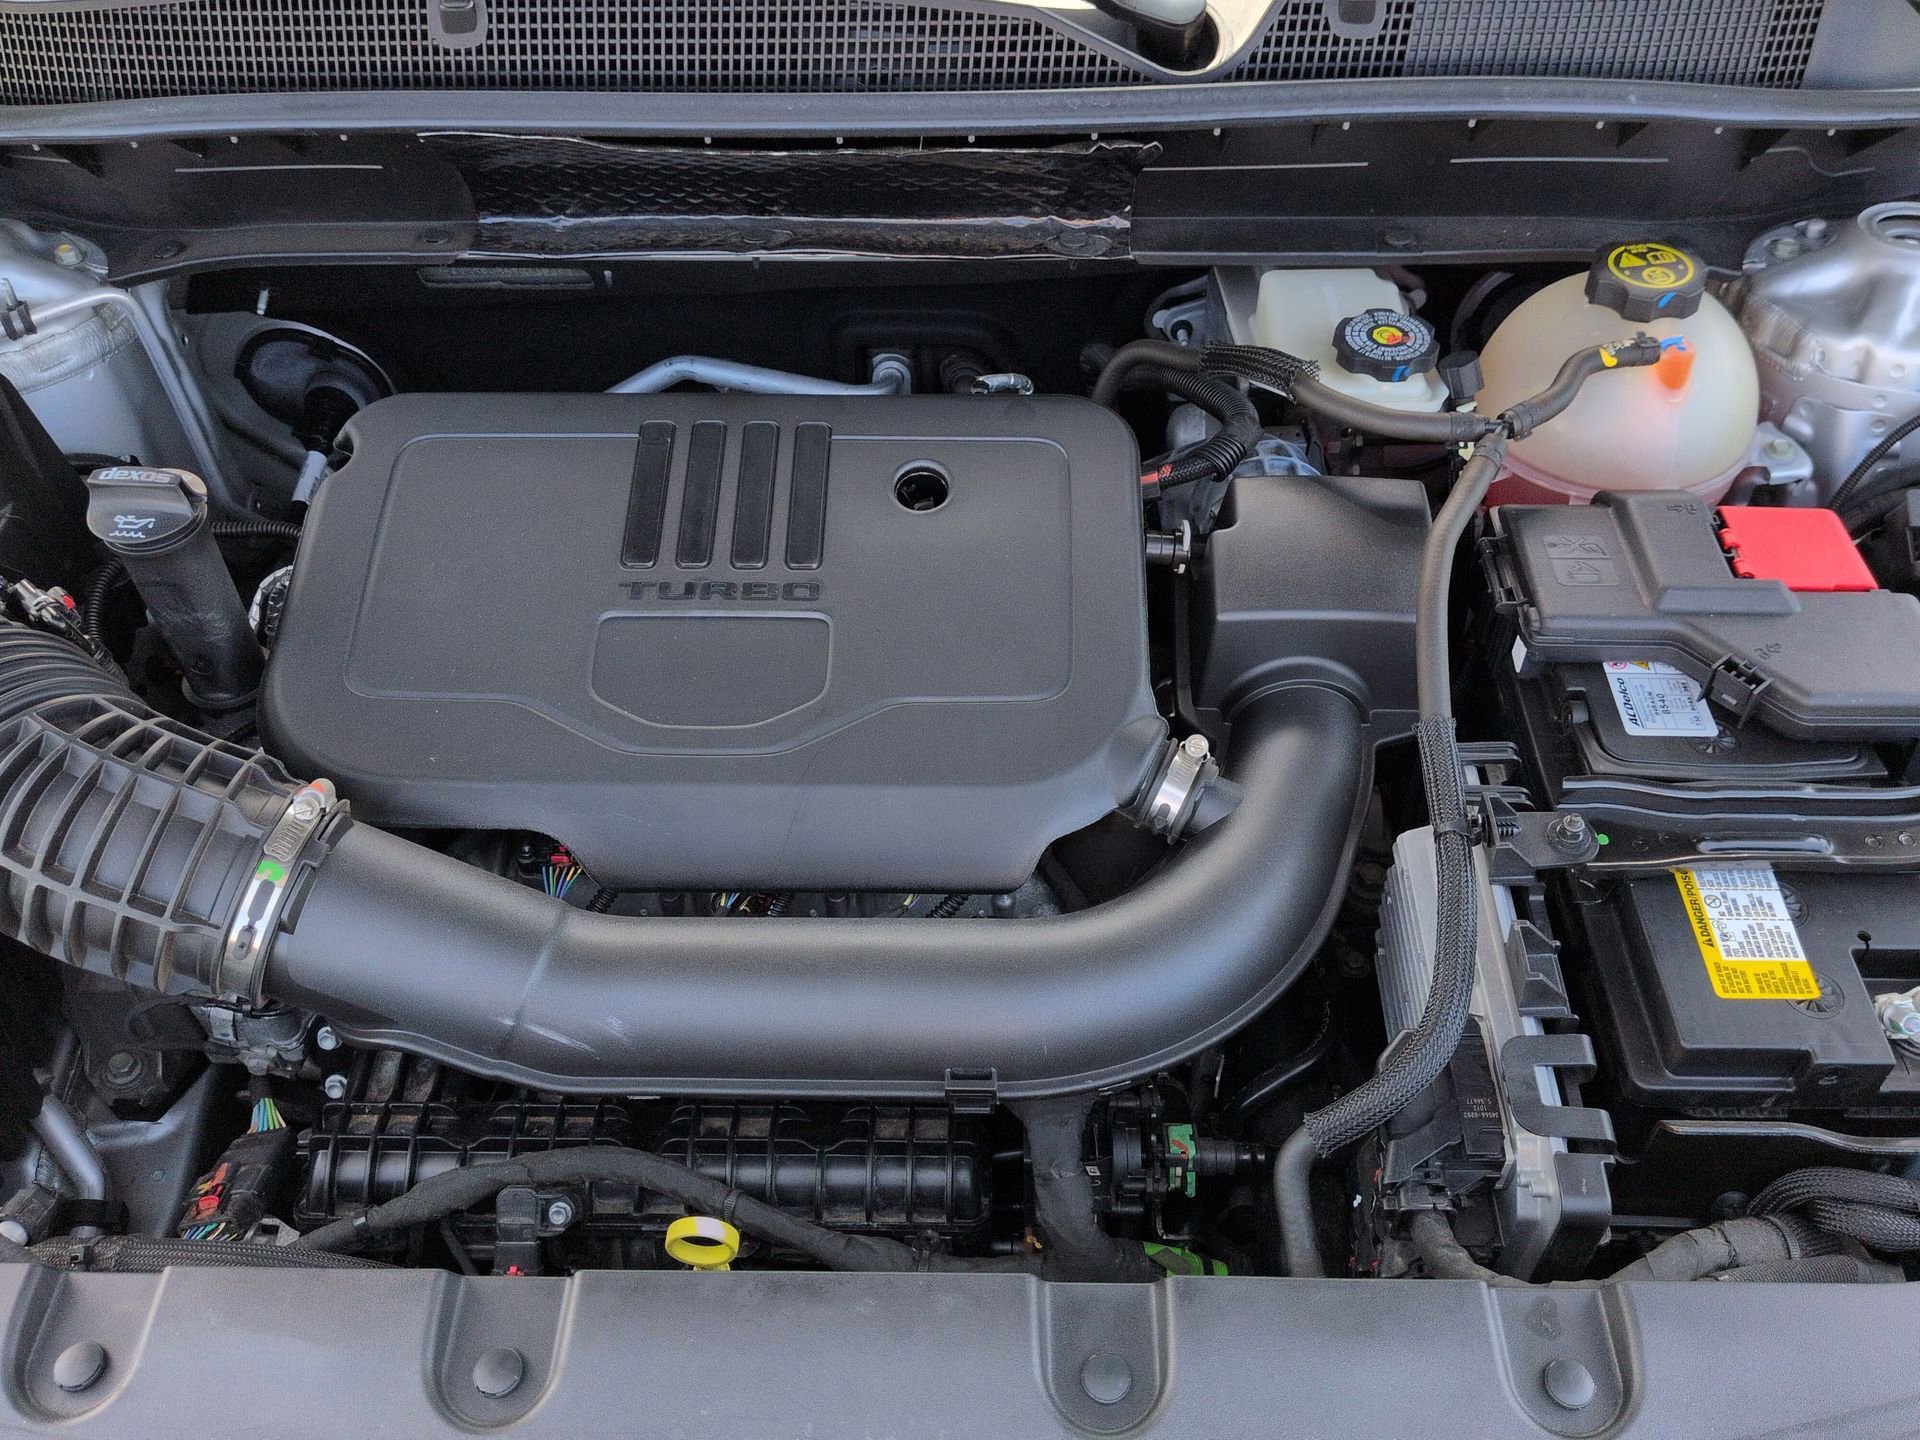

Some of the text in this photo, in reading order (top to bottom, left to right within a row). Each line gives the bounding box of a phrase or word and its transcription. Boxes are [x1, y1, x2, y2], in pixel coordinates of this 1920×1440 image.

[98, 467, 174, 483] dexos
[618, 581, 820, 601] TURBO
[1616, 677, 1640, 727] ACDelco
